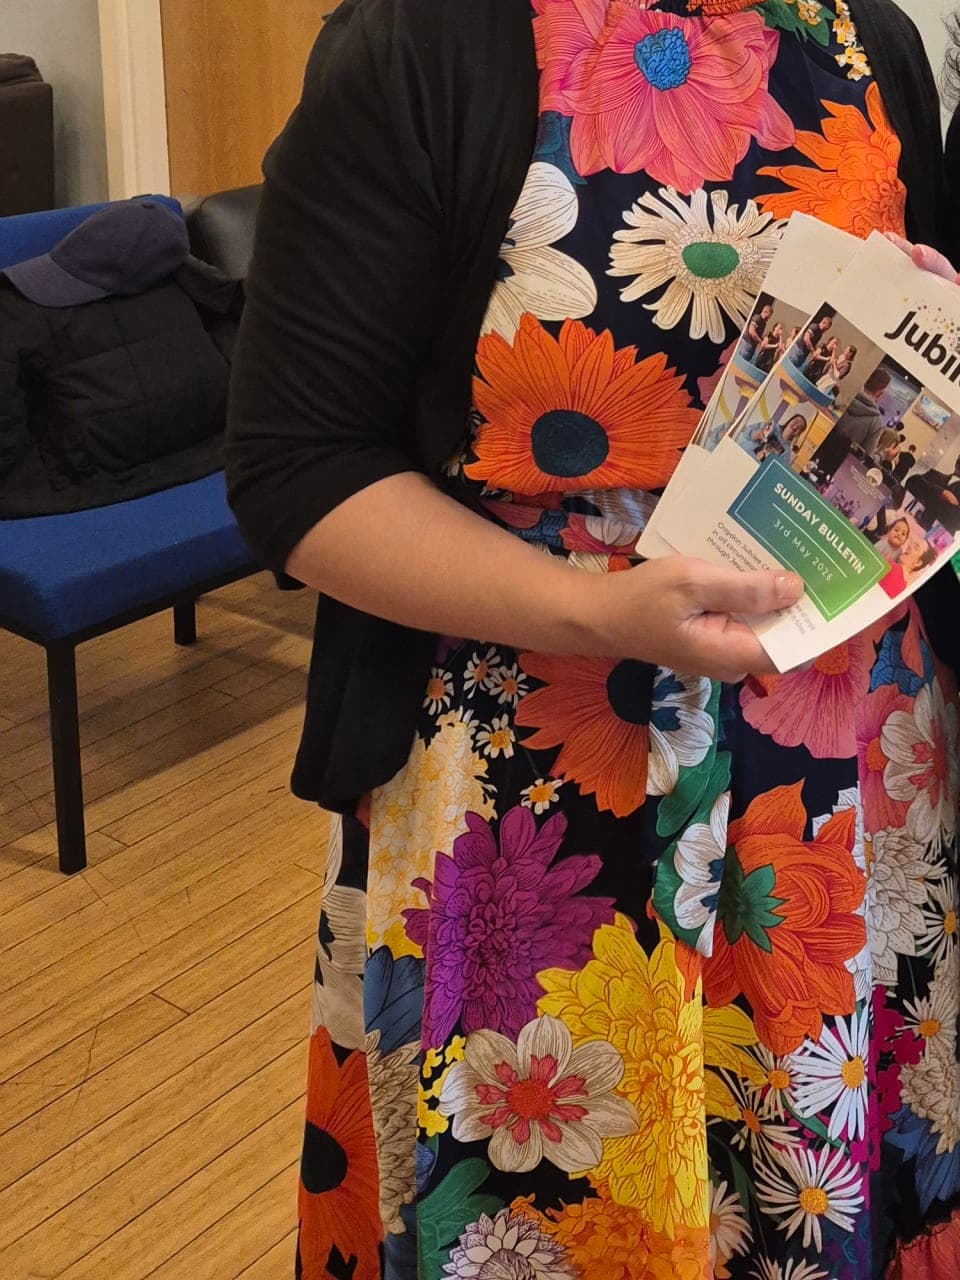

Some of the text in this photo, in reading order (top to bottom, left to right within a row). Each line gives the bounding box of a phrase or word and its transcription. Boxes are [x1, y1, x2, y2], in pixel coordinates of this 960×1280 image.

[773, 482, 820, 526] SUNDAY
[818, 523, 866, 575] BULLETIN
[773, 519, 834, 582] 3rd May 2026
